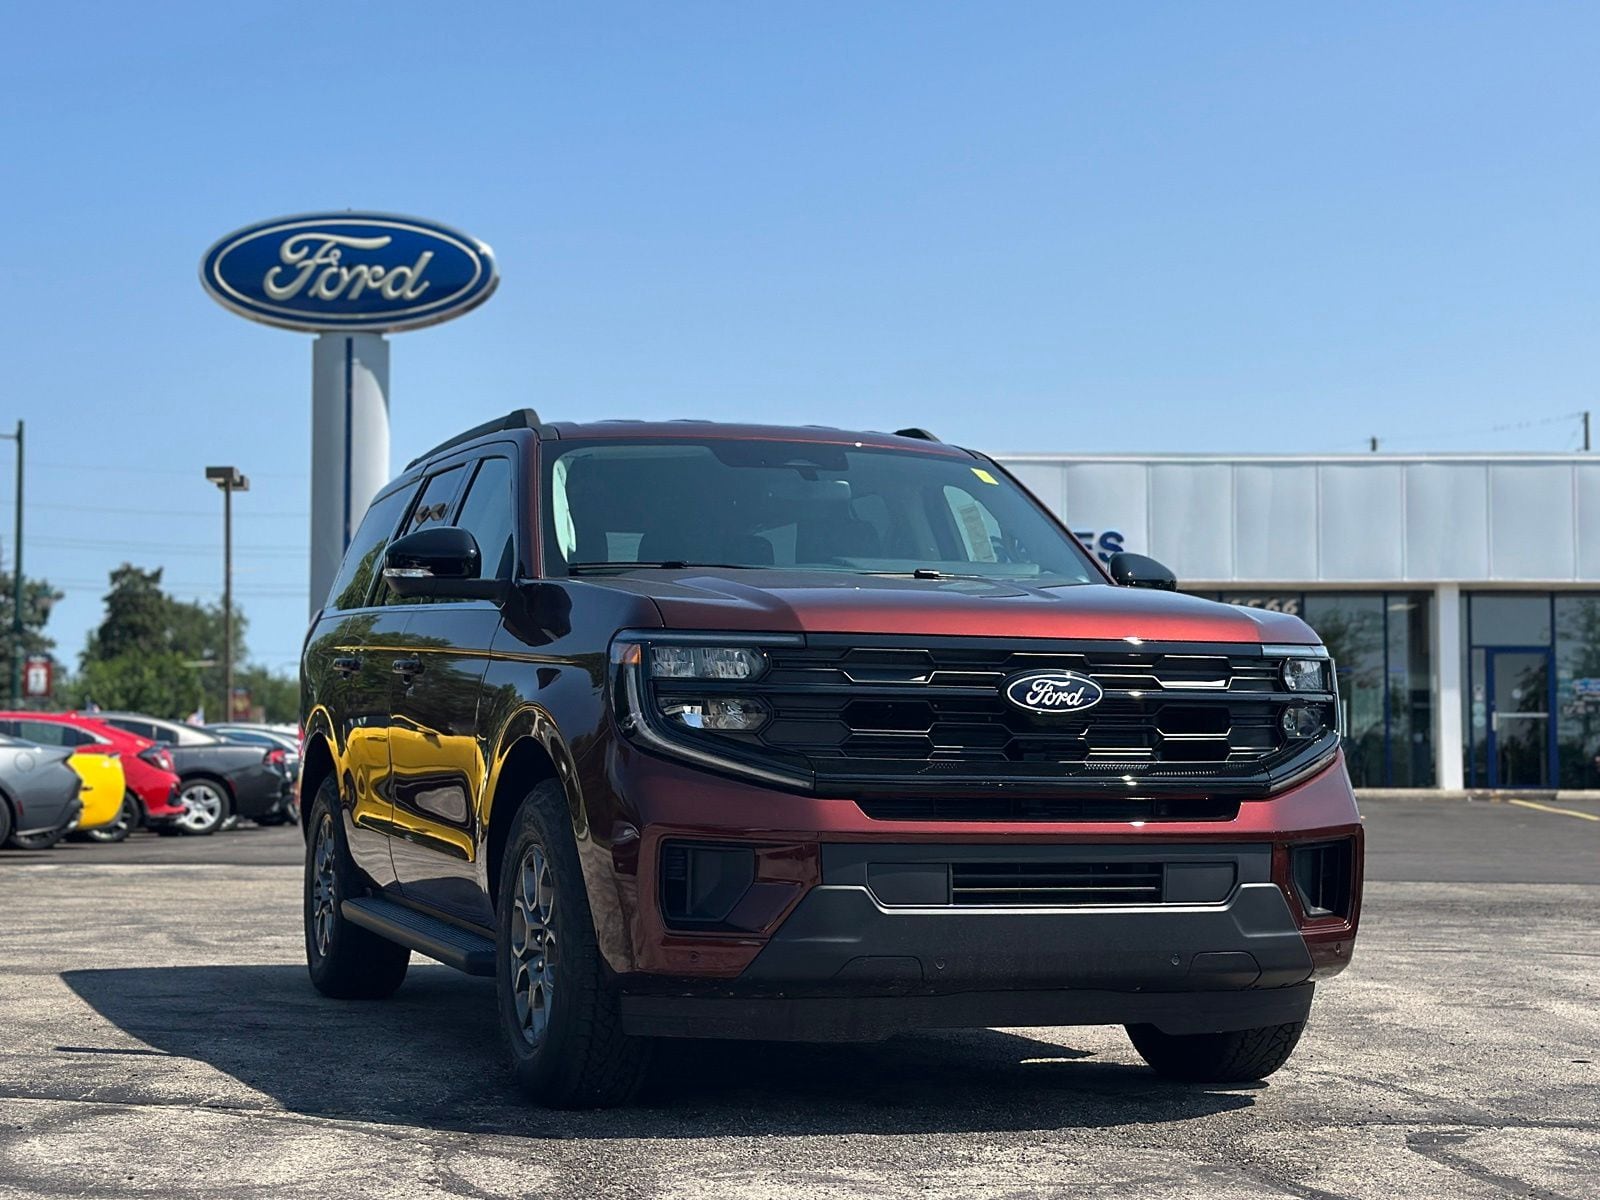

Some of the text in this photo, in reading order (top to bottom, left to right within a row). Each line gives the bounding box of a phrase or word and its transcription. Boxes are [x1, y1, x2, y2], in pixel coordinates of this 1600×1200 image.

[263, 232, 434, 301] Ford
[1231, 599, 1298, 615] 66
[1026, 679, 1085, 706] Ford
